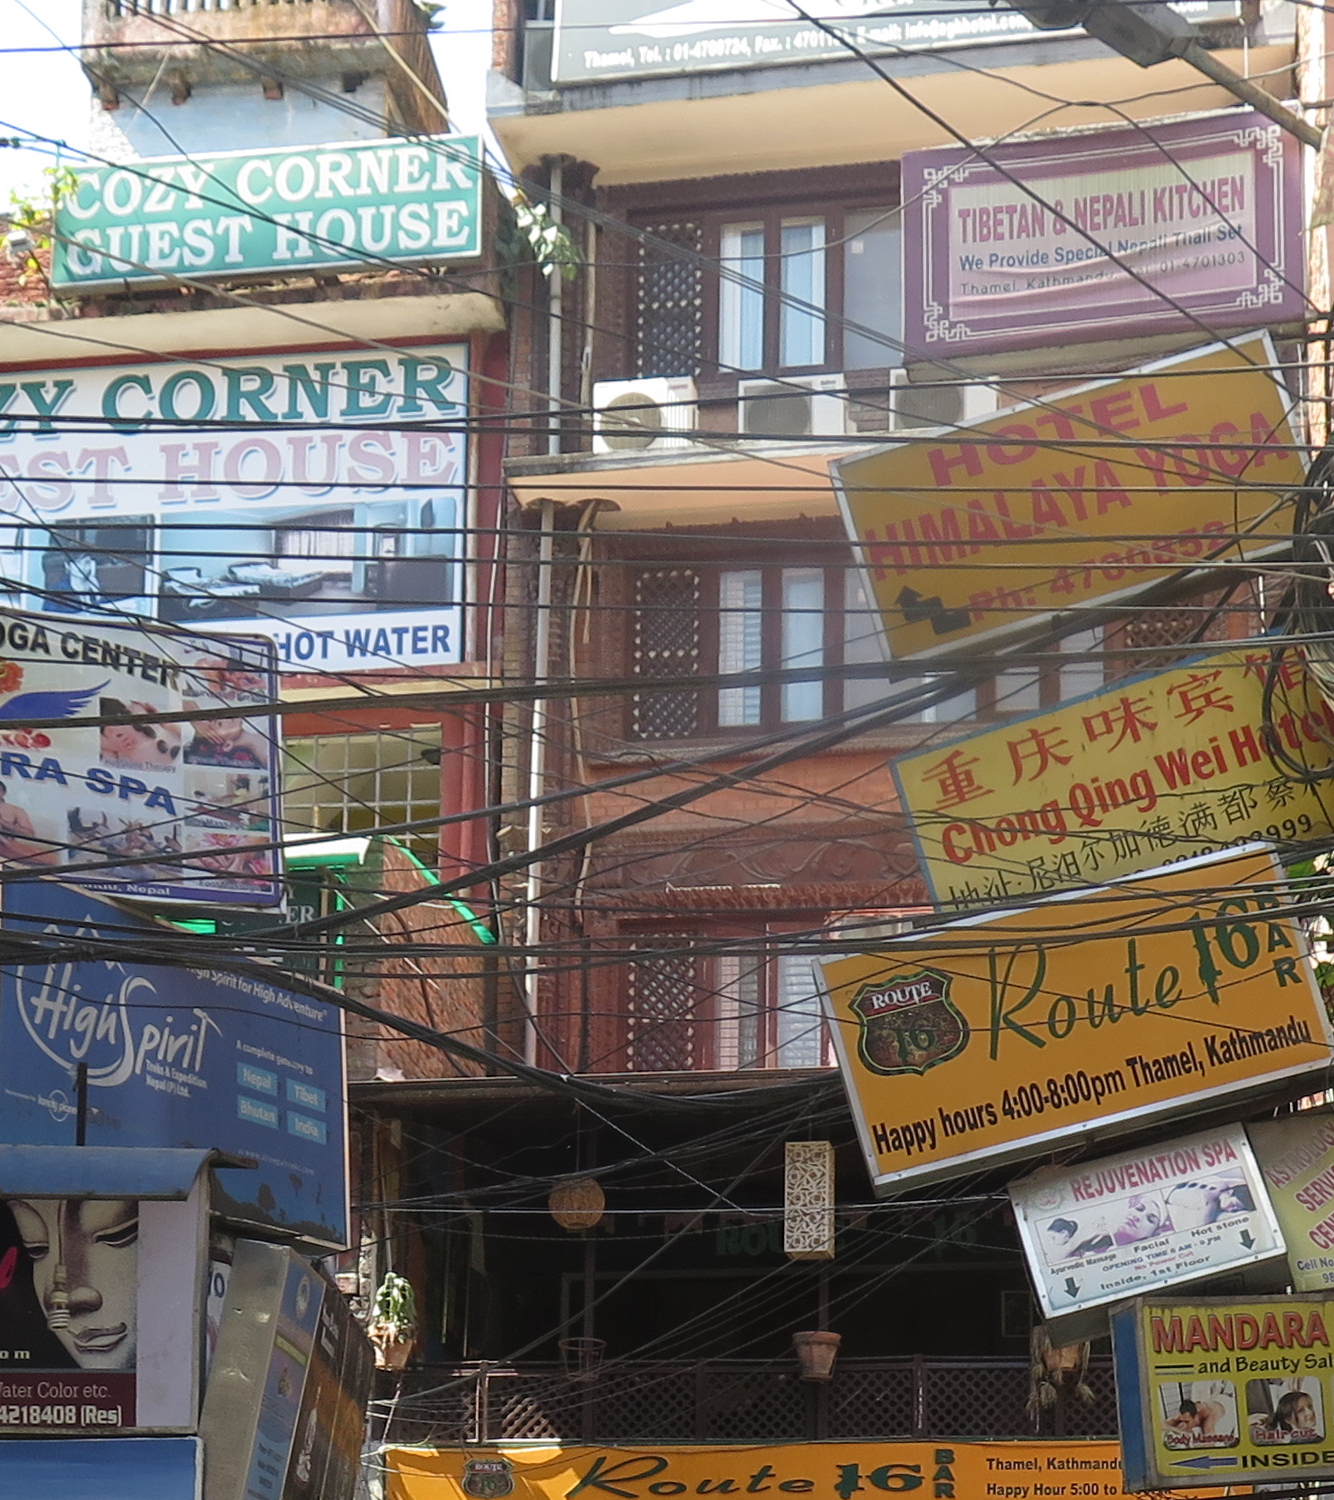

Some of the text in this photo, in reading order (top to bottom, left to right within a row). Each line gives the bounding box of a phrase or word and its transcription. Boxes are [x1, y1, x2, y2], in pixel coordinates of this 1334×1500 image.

[67, 146, 474, 221] COZY CORNER
[958, 174, 1246, 244] TIBETAN & NEPALI KITCHEN
[67, 200, 471, 277] GUEST HOUSE
[100, 354, 463, 434] CORNER
[926, 382, 1189, 488] HOTEL
[158, 428, 461, 505] HOUSE
[864, 410, 1293, 584] HIMALAYA YOGA
[59, 634, 183, 690] CENTER
[344, 623, 452, 658] WATER
[83, 766, 179, 818] SPA
[941, 796, 1067, 866] Chong
[1069, 768, 1158, 828] Qing
[1153, 734, 1228, 792] Wei
[870, 979, 933, 1012] ROUTE
[985, 937, 1181, 1062] Route
[871, 1015, 1313, 1159] Happy hours 4:00-8:00pm Thamel, Kathmandu
[240, 1102, 319, 1138] Bhutan India
[1069, 1138, 1238, 1202] REJUVENATION SPA
[1151, 1309, 1330, 1354] MANDARA
[36, 1380, 79, 1398] Color
[82, 1382, 112, 1398] etc.
[1197, 1357, 1231, 1375] and
[1235, 1354, 1302, 1375] Beauty
[80, 1402, 122, 1427] (Res)
[565, 1455, 815, 1500] Route
[933, 1448, 956, 1500] BAR
[986, 1479, 1118, 1500] Happy Hour 5:00 to
